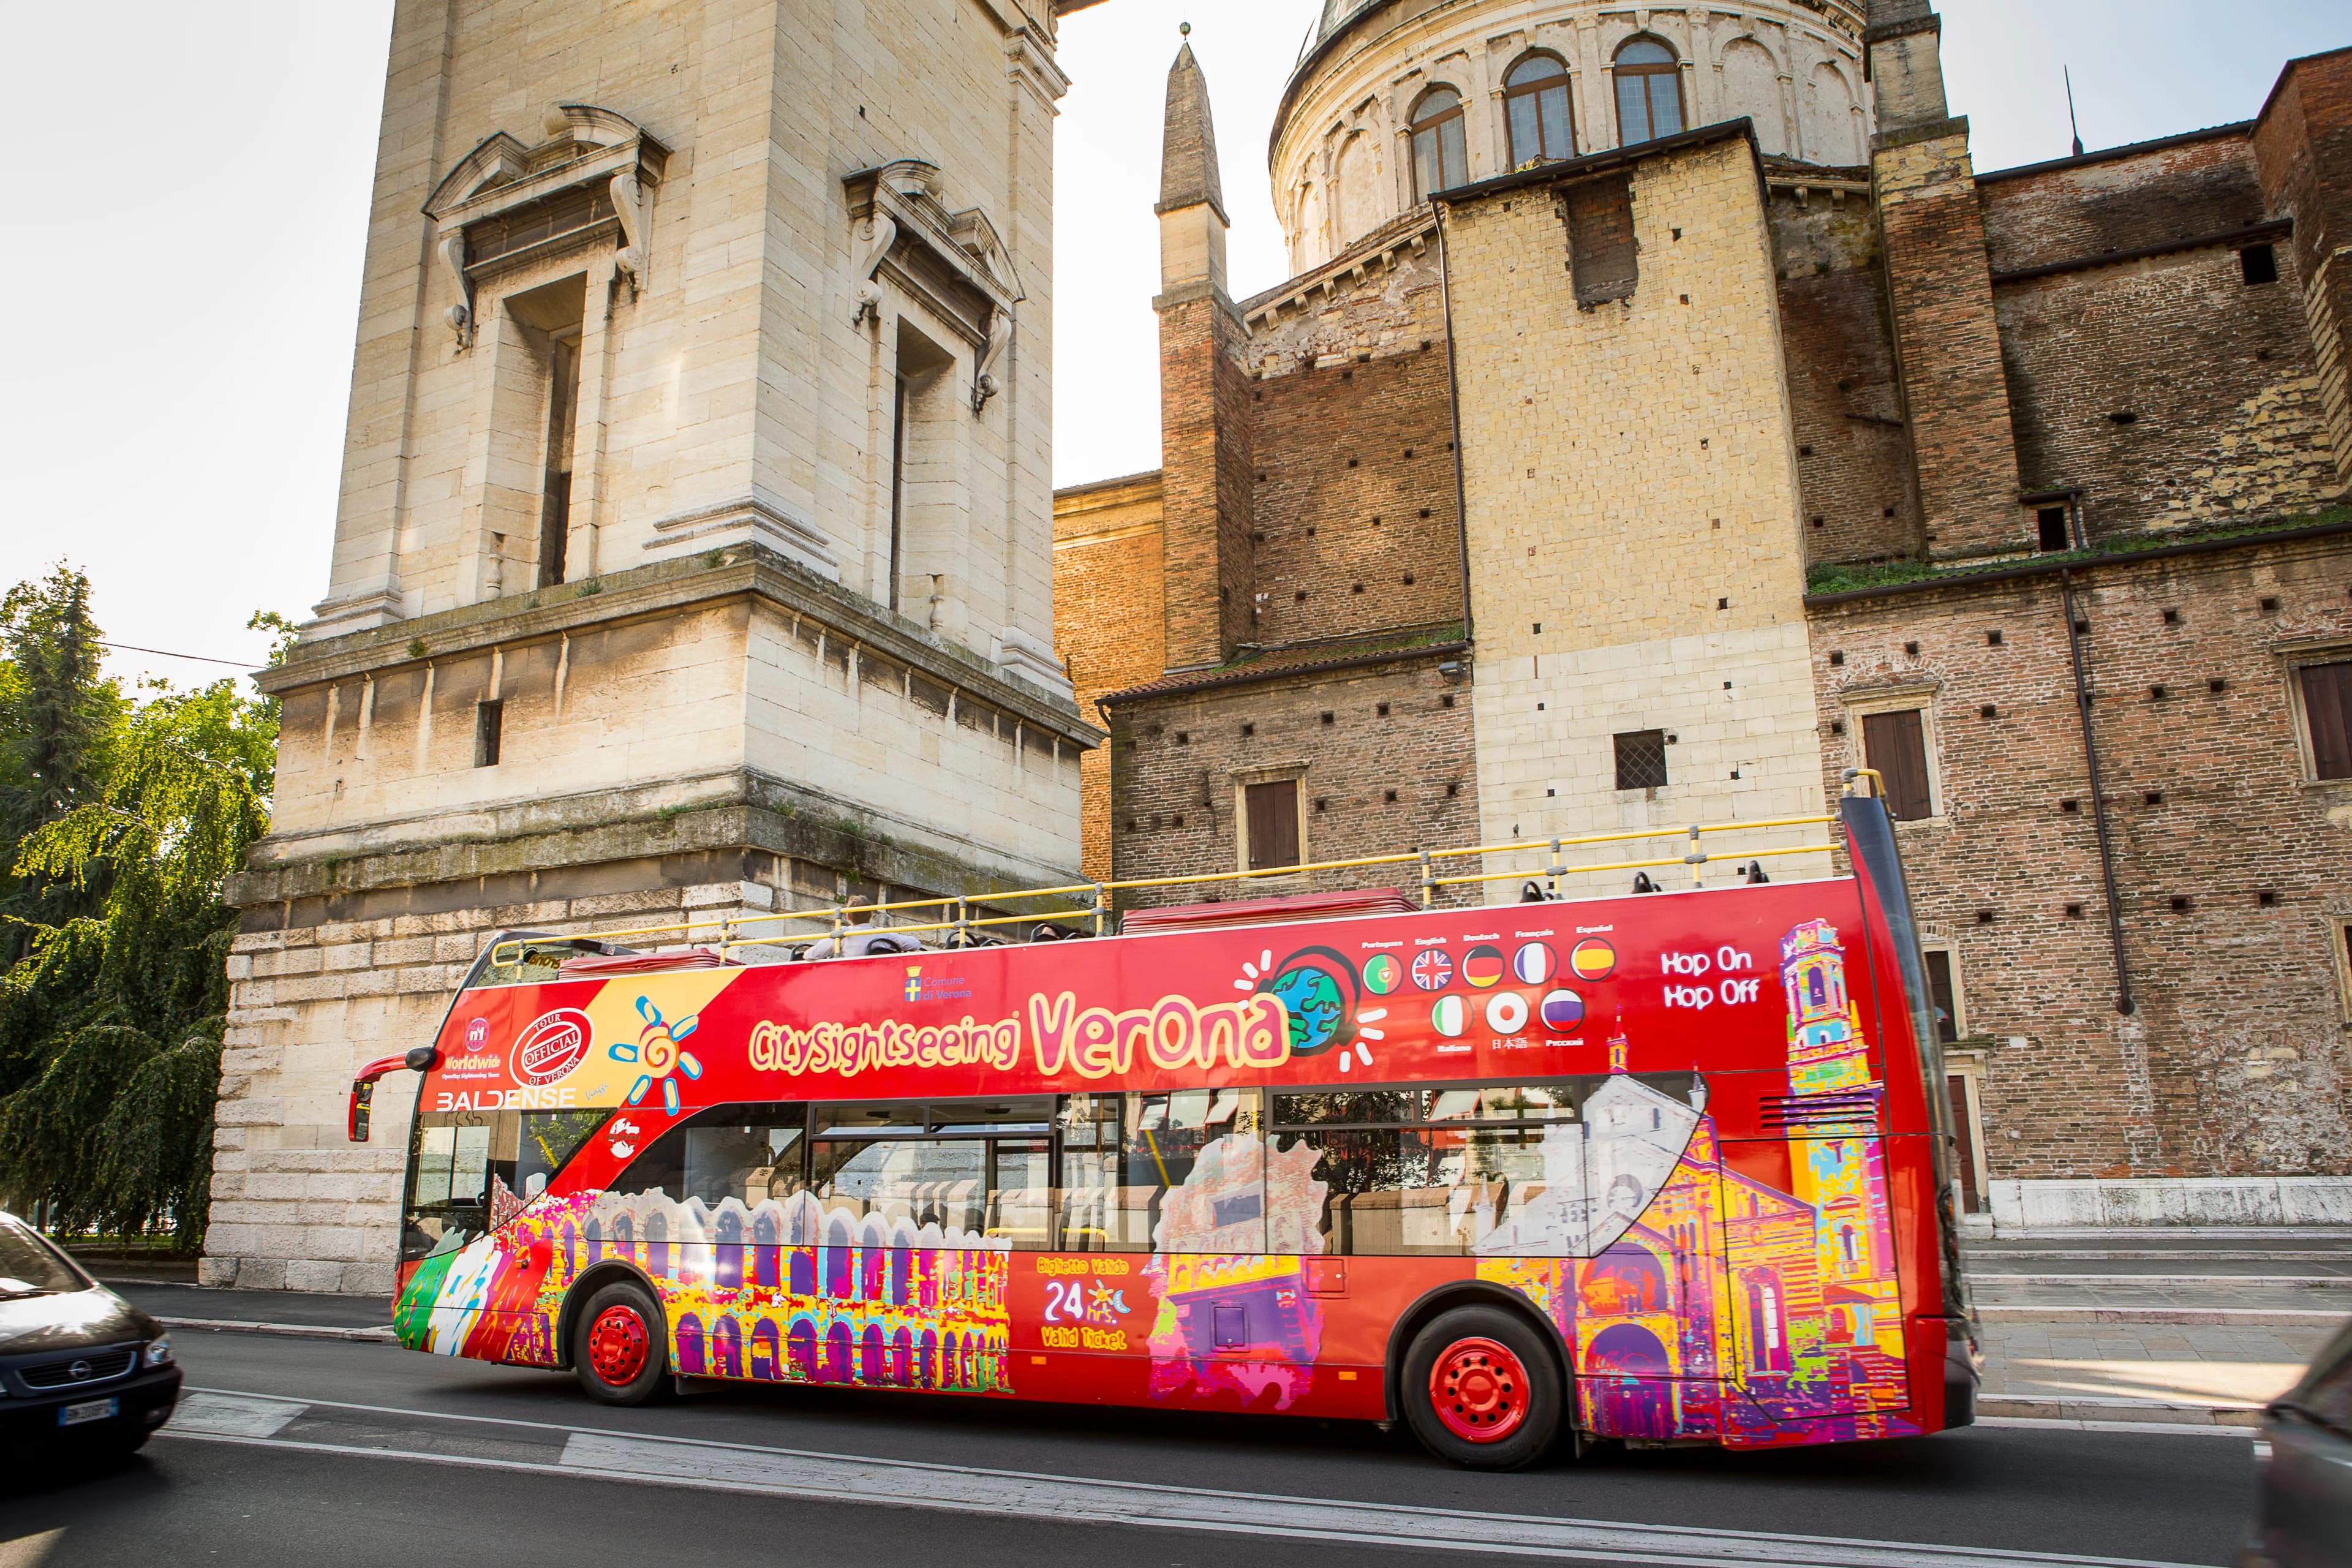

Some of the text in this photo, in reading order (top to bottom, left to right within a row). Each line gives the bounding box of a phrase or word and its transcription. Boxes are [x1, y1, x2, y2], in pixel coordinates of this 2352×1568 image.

[1414, 937, 1447, 946] English
[1660, 945, 1752, 977] Hop On
[924, 977, 965, 987] Comune
[923, 989, 972, 1000] di Verona
[1664, 978, 1760, 1011] Hop Off
[533, 1014, 561, 1031] TOUR
[524, 1031, 579, 1066] OFFICIAL
[1492, 1037, 1528, 1050] 日本語
[445, 1054, 501, 1070] Worldwide
[529, 1057, 580, 1086] OF VERONA
[435, 1087, 576, 1112] BALDENSE
[1037, 1257, 1129, 1276] Biglietto Valido
[1043, 1279, 1084, 1324] 24
[1041, 1326, 1128, 1351] Valid Ticket
